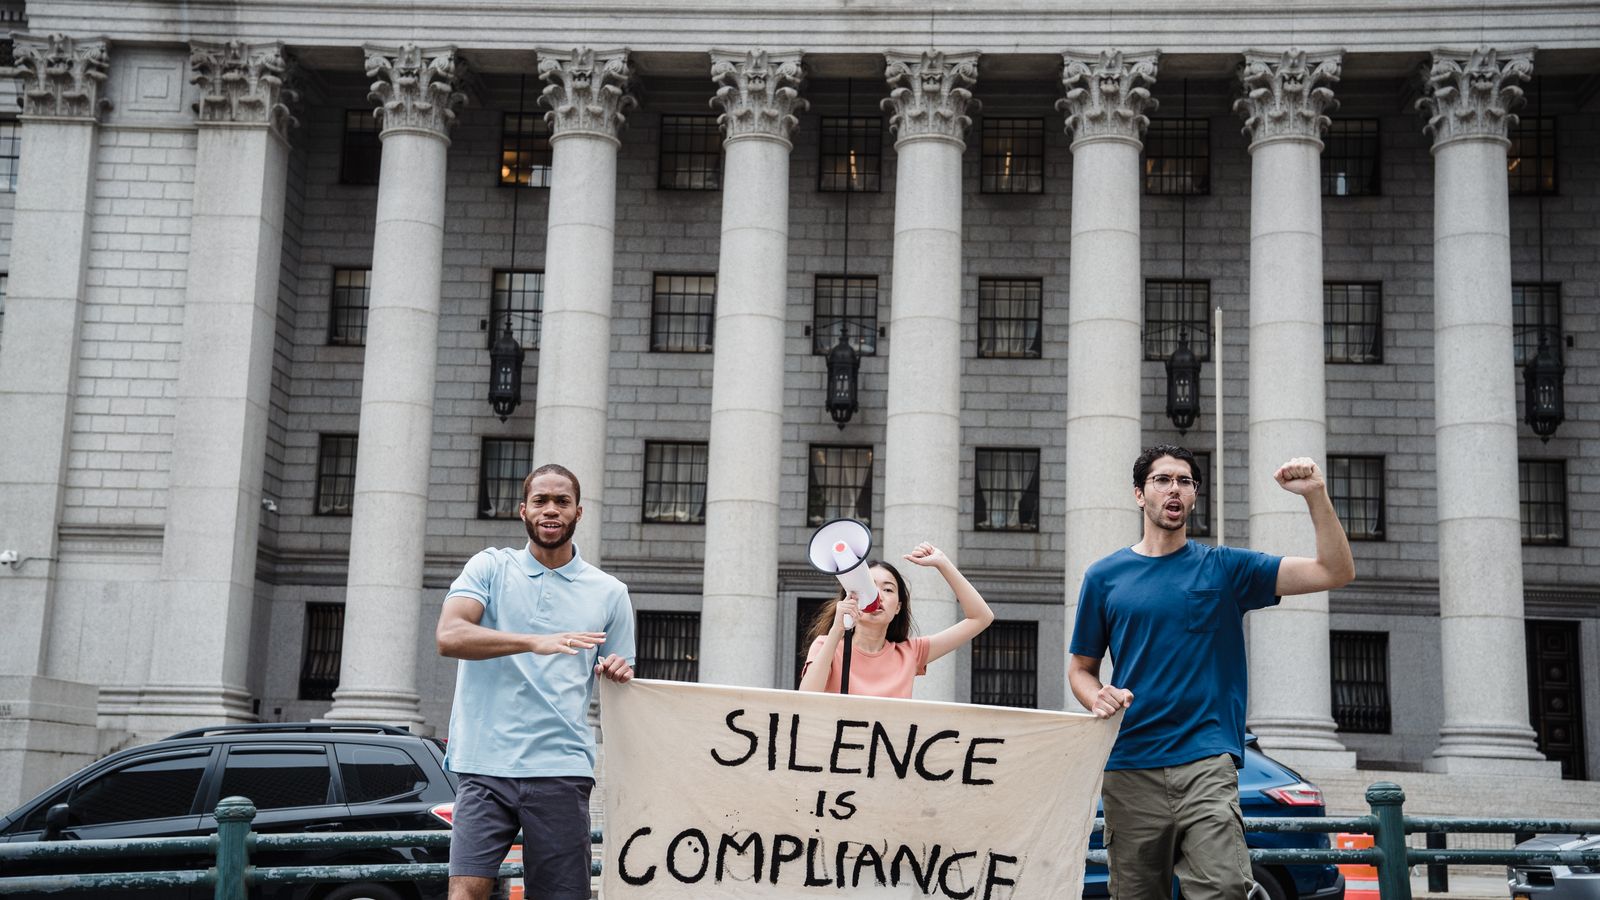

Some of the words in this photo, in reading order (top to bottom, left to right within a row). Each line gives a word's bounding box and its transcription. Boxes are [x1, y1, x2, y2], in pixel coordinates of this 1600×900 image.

[710, 709, 1005, 786] SILENCE
[815, 789, 857, 821] IS
[618, 826, 1018, 900] COMPLIANCE
